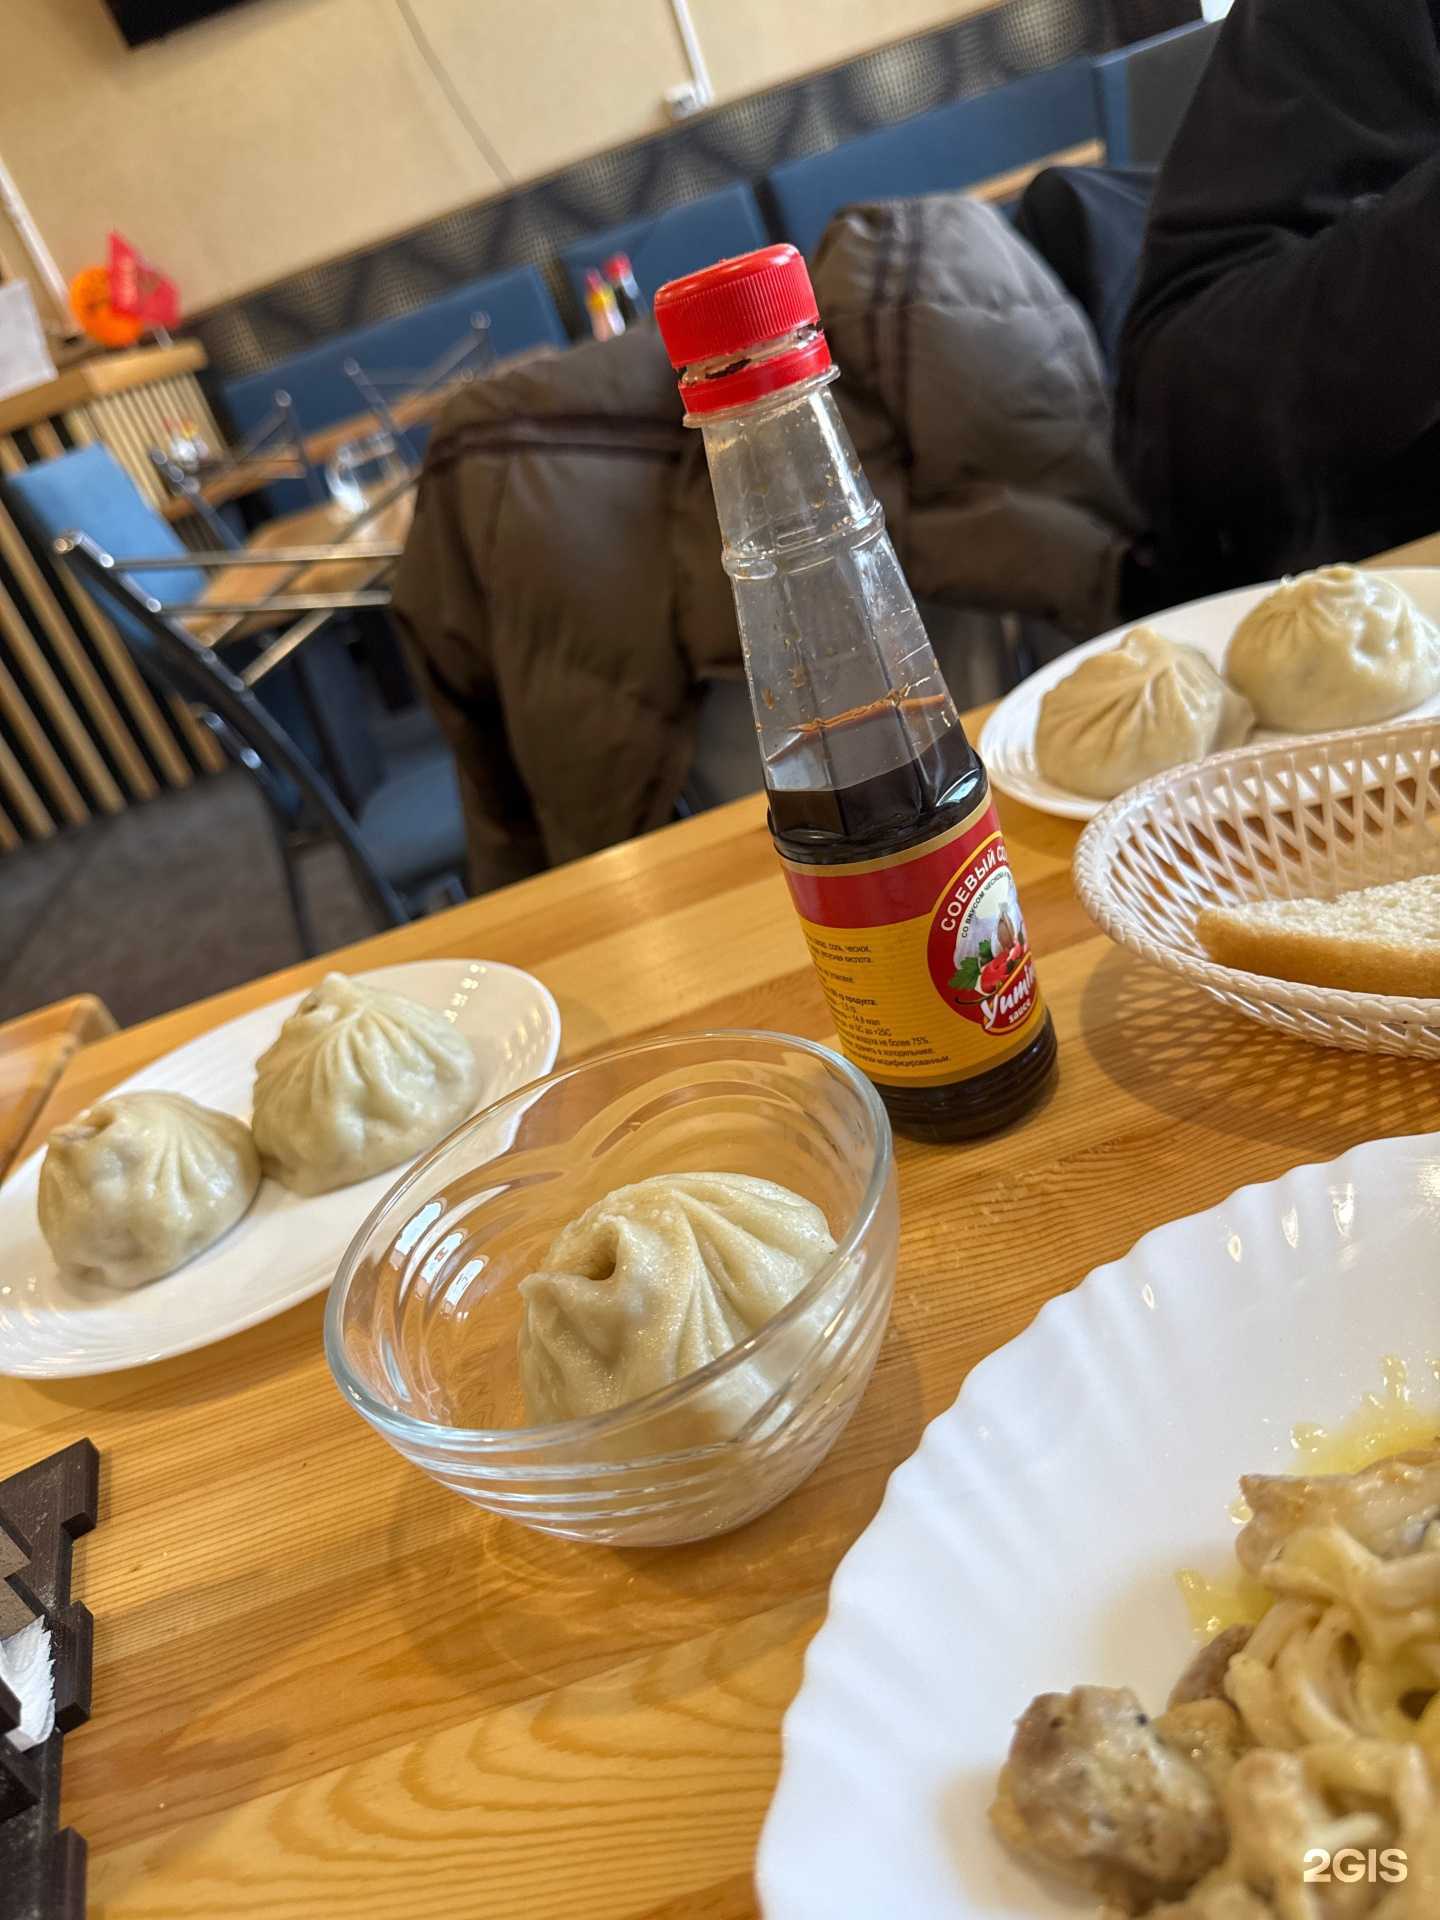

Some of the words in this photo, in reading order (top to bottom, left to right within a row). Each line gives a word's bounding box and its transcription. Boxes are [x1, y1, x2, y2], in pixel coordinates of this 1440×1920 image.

[941, 847, 996, 931] СОЕВЫЙ
[961, 926, 969, 938] СО
[965, 890, 985, 925] ВКУСОМ
